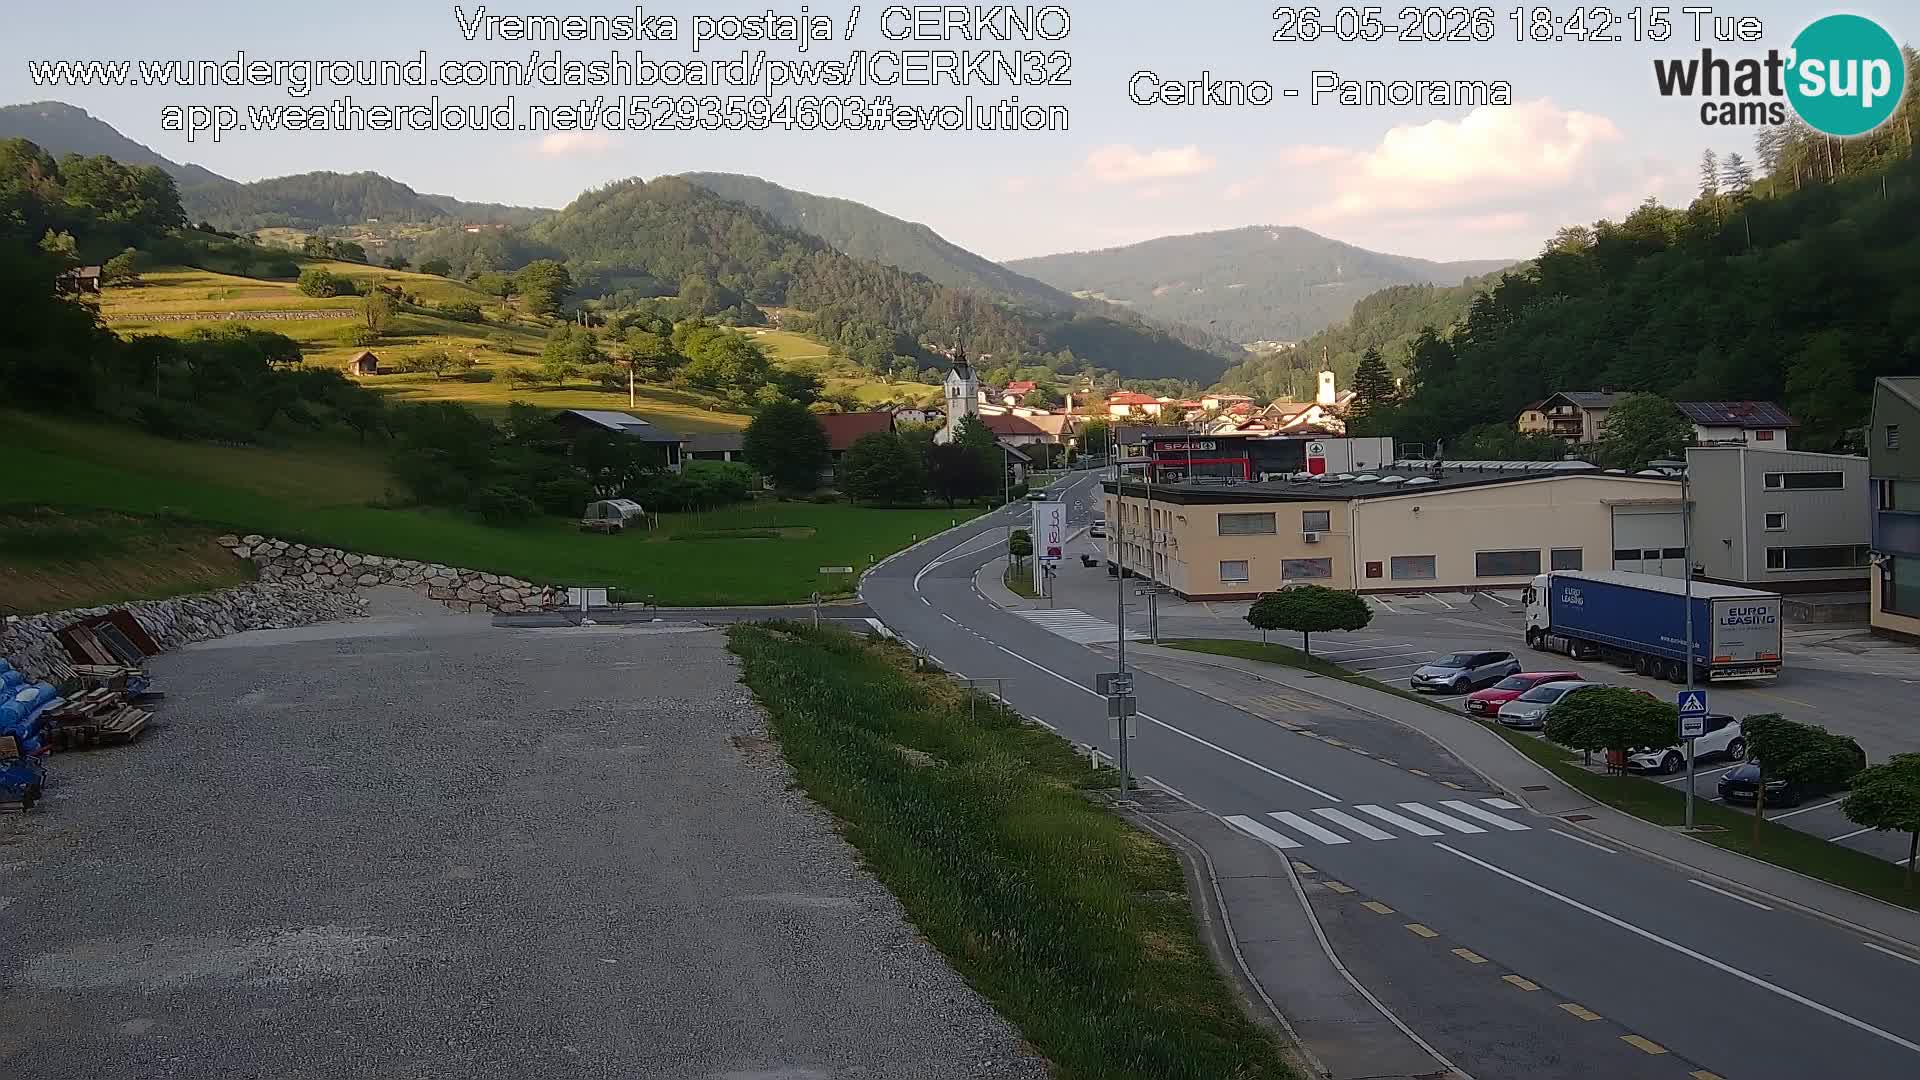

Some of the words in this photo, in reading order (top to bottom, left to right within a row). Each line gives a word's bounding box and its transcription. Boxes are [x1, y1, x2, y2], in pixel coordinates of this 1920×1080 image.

[1164, 442, 1200, 450] SPAR
[1729, 606, 1767, 617] EURO
[1720, 615, 1776, 626] LEASING
